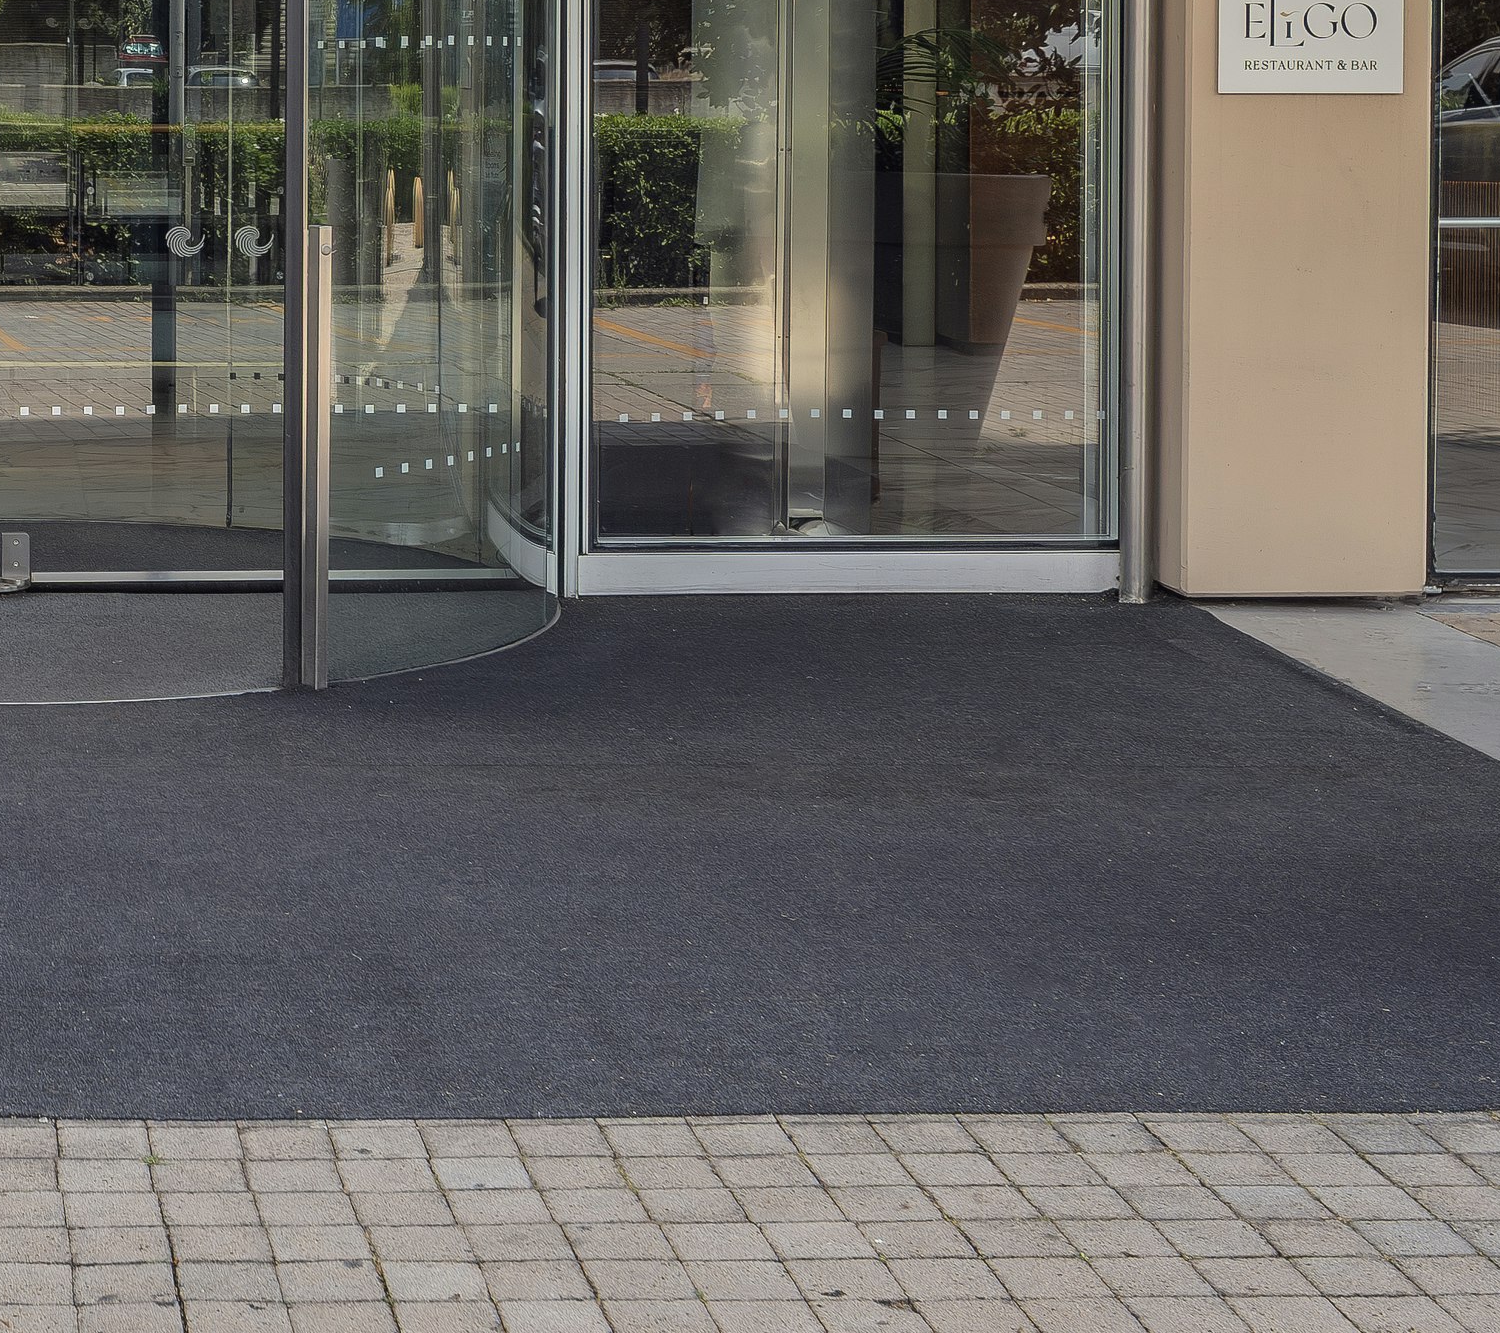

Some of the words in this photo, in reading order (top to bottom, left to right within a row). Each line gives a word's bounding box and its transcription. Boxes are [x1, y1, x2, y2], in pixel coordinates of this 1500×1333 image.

[1244, 59, 1334, 71] RESTAURANT
[1337, 59, 1348, 71] &
[1351, 59, 1378, 71] BAR
